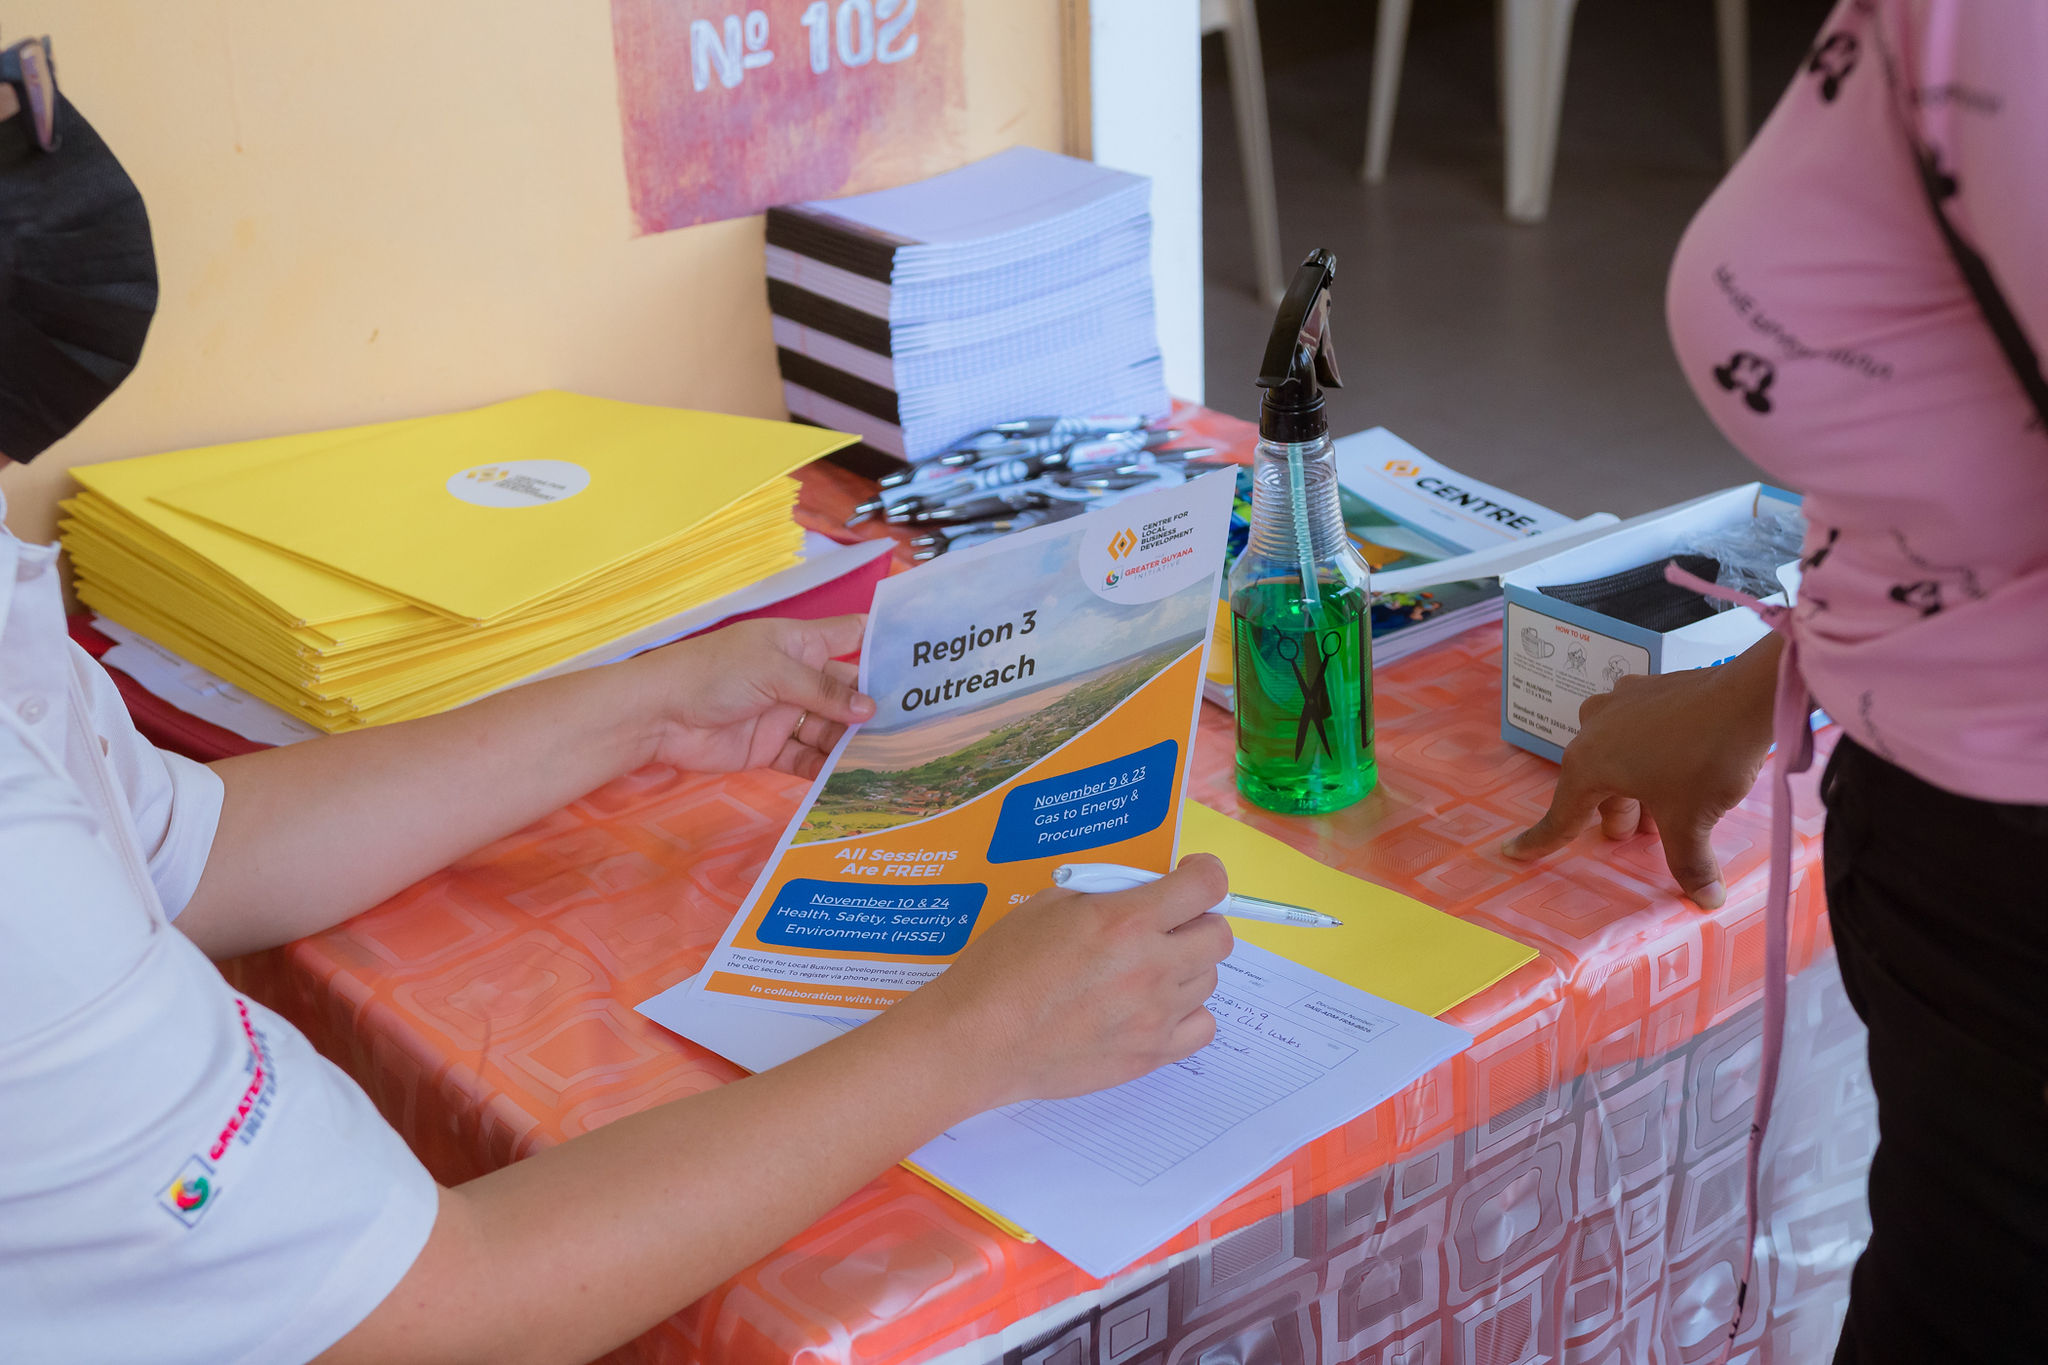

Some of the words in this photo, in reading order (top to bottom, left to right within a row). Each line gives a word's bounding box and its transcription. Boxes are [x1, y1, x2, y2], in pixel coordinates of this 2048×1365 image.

[800, 0, 918, 74] 102
[1142, 517, 1172, 531] CENTRE
[1173, 511, 1189, 521] FOR
[1140, 528, 1177, 545] BUSINESS
[1140, 528, 1194, 552] DEVELOPMENT
[1141, 526, 1166, 538] LOCAL
[1125, 560, 1160, 577] GREATER
[1161, 547, 1194, 565] GUYANA
[912, 622, 1013, 667] Region
[1020, 609, 1037, 635] 3
[1555, 625, 1569, 634] HOW
[1571, 630, 1578, 638] TO
[1580, 633, 1590, 642] USE
[901, 654, 1036, 712] Outreach
[1528, 719, 1535, 727] IN
[1535, 722, 1553, 735] CHINA
[1034, 782, 1106, 810] November
[1108, 776, 1117, 789] 9
[1120, 772, 1129, 785] &
[1131, 766, 1146, 781] 23
[1034, 811, 1060, 826] Gas
[1062, 807, 1077, 820] to
[1080, 794, 1128, 816] Energy
[1130, 789, 1139, 801] &
[1037, 813, 1129, 844] Procurement
[835, 848, 864, 860] All
[868, 849, 958, 862] Sessions
[840, 863, 877, 876] Are
[882, 864, 944, 877] FREE!
[810, 893, 894, 909] November
[896, 899, 915, 910] 10
[917, 899, 927, 909] &
[929, 898, 950, 909] 24
[777, 907, 831, 921] Health,
[836, 911, 886, 925] Safety,
[891, 914, 955, 927] Security
[958, 914, 968, 925] &
[785, 923, 888, 940] Environment
[891, 930, 946, 943] (HSSE)
[732, 953, 746, 961] The
[748, 956, 774, 964] Centre
[788, 961, 808, 969] Local
[810, 963, 843, 972] Business
[845, 966, 897, 975] Development
[761, 966, 786, 975] sector.
[800, 971, 829, 979] register
[842, 974, 869, 982] phone
[764, 987, 842, 1001] collaboration
[845, 995, 872, 1005] with
[875, 997, 894, 1006] the
